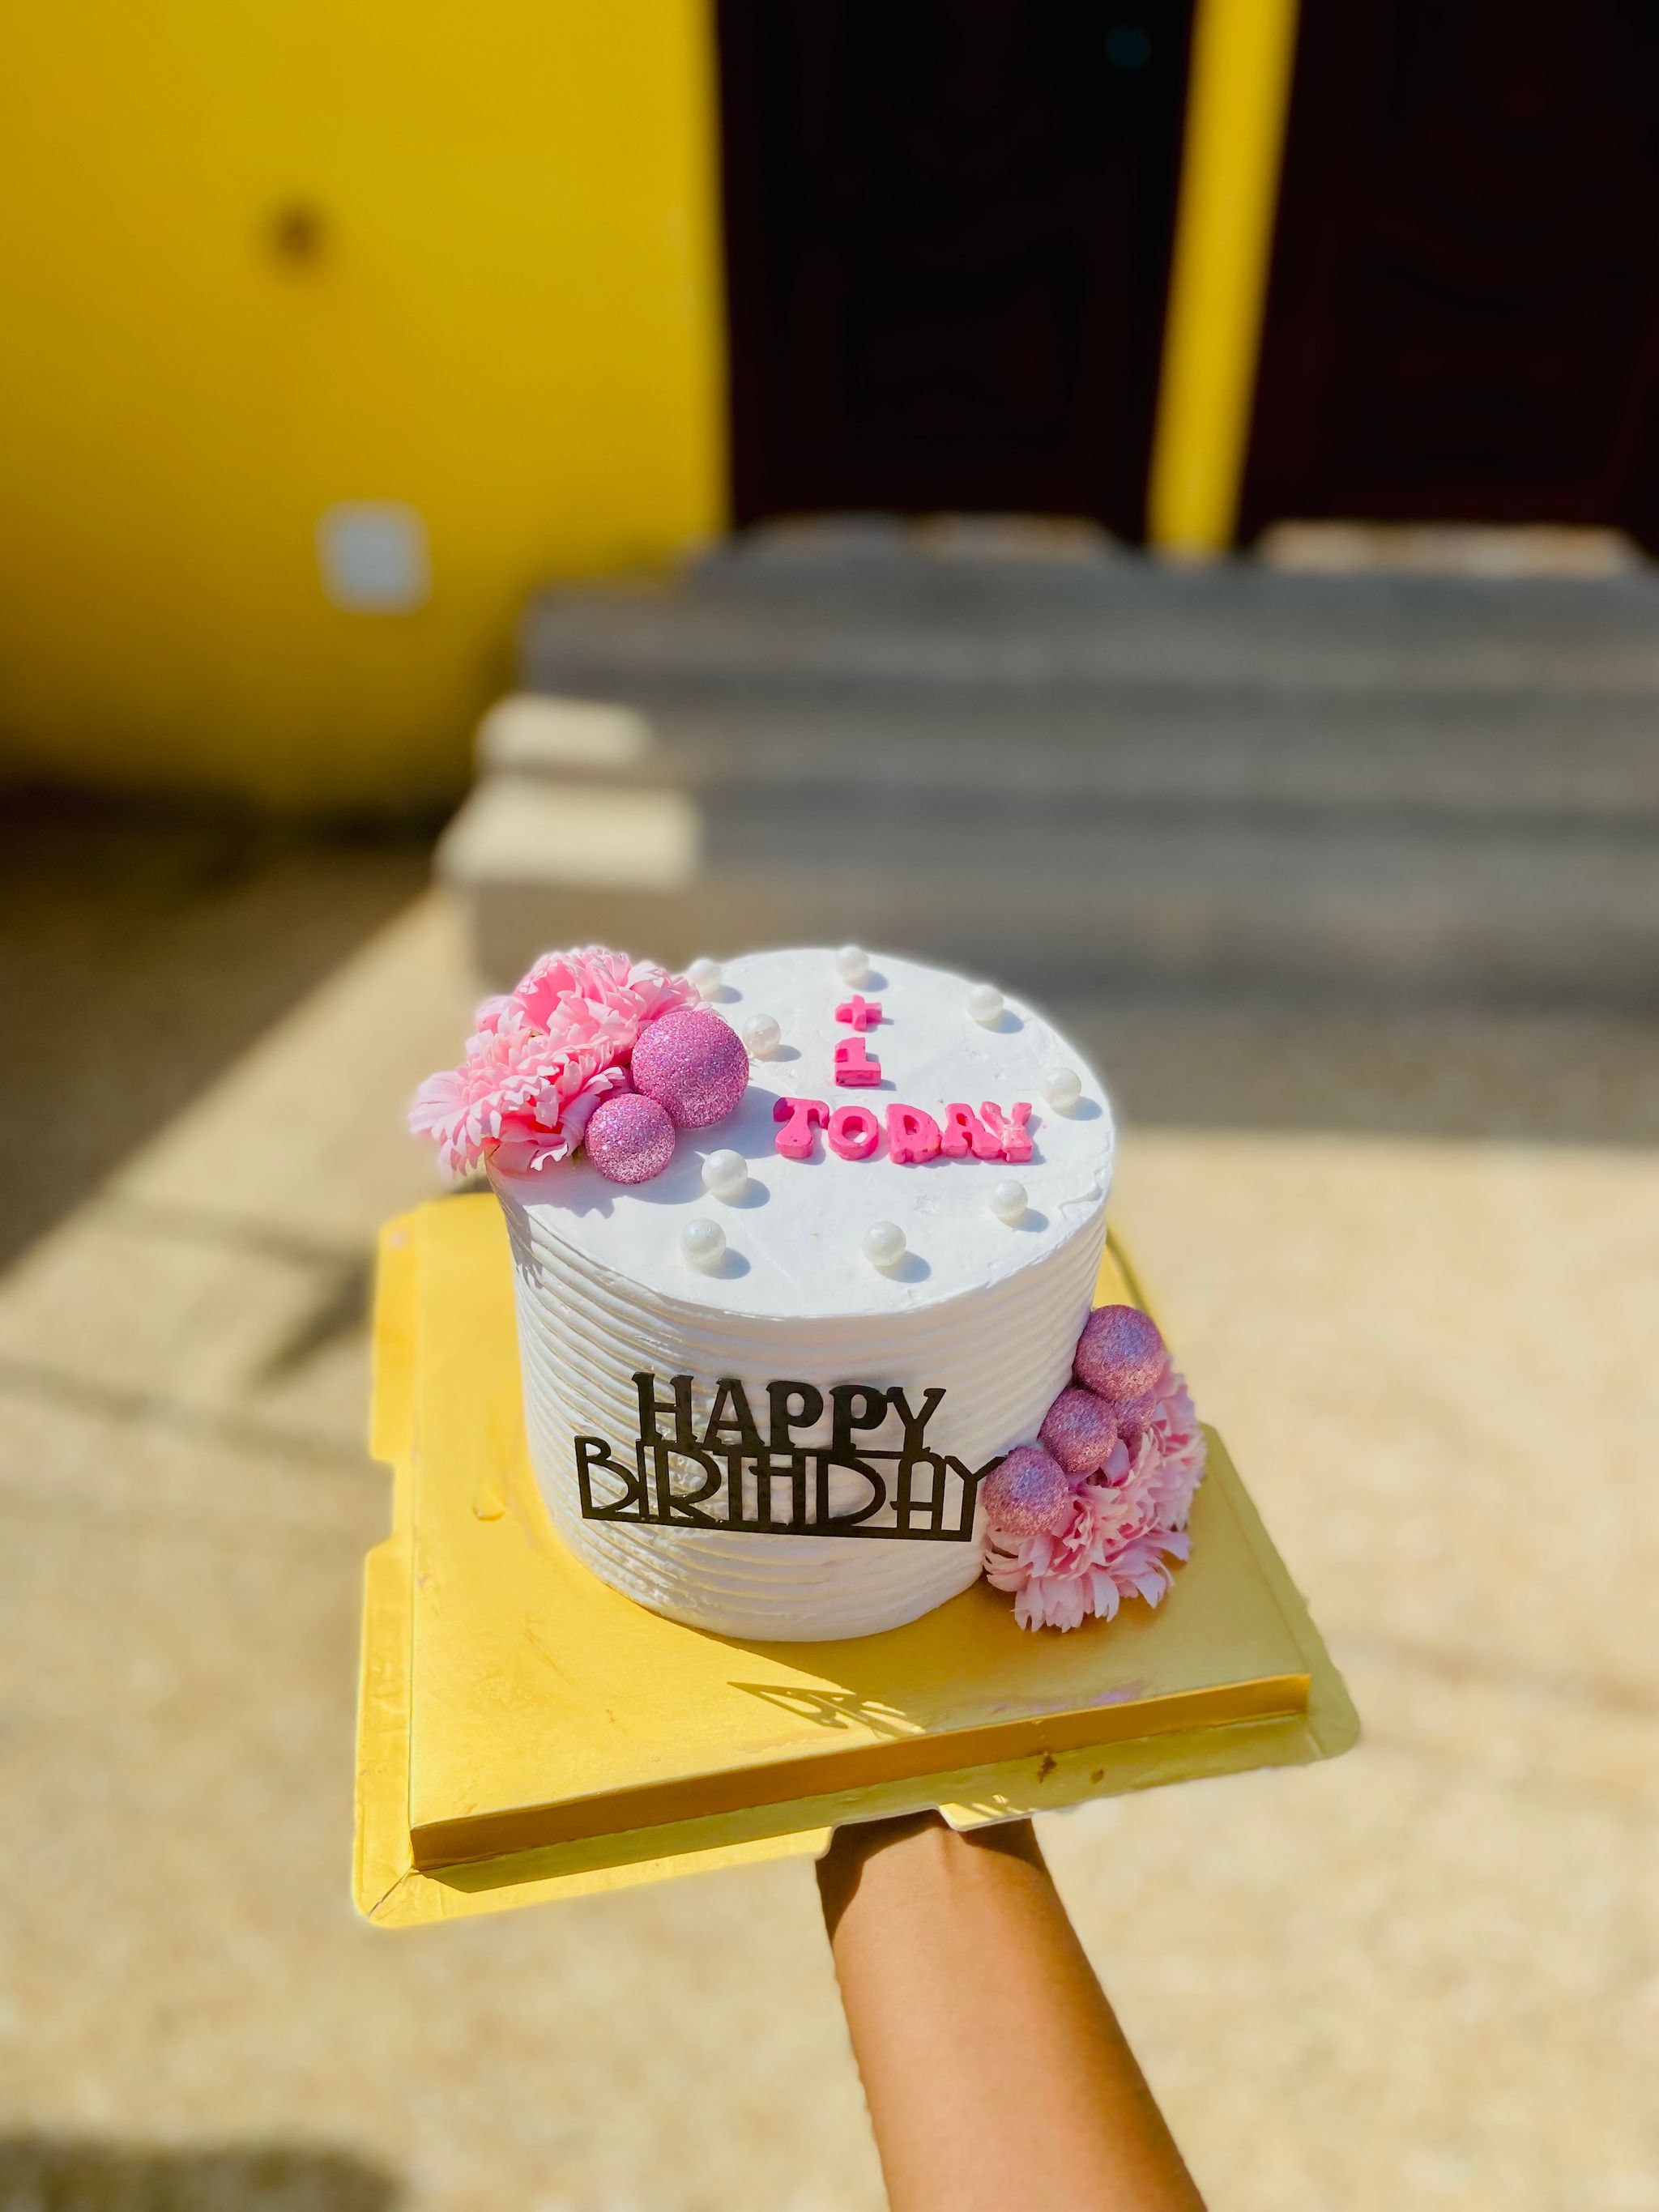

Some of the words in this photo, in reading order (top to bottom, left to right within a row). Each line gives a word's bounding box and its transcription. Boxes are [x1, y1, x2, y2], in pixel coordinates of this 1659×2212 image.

[773, 1097, 1033, 1164] TODAY
[632, 1371, 947, 1455] HAPPY
[574, 1435, 1008, 1541] BIRTHDAY
